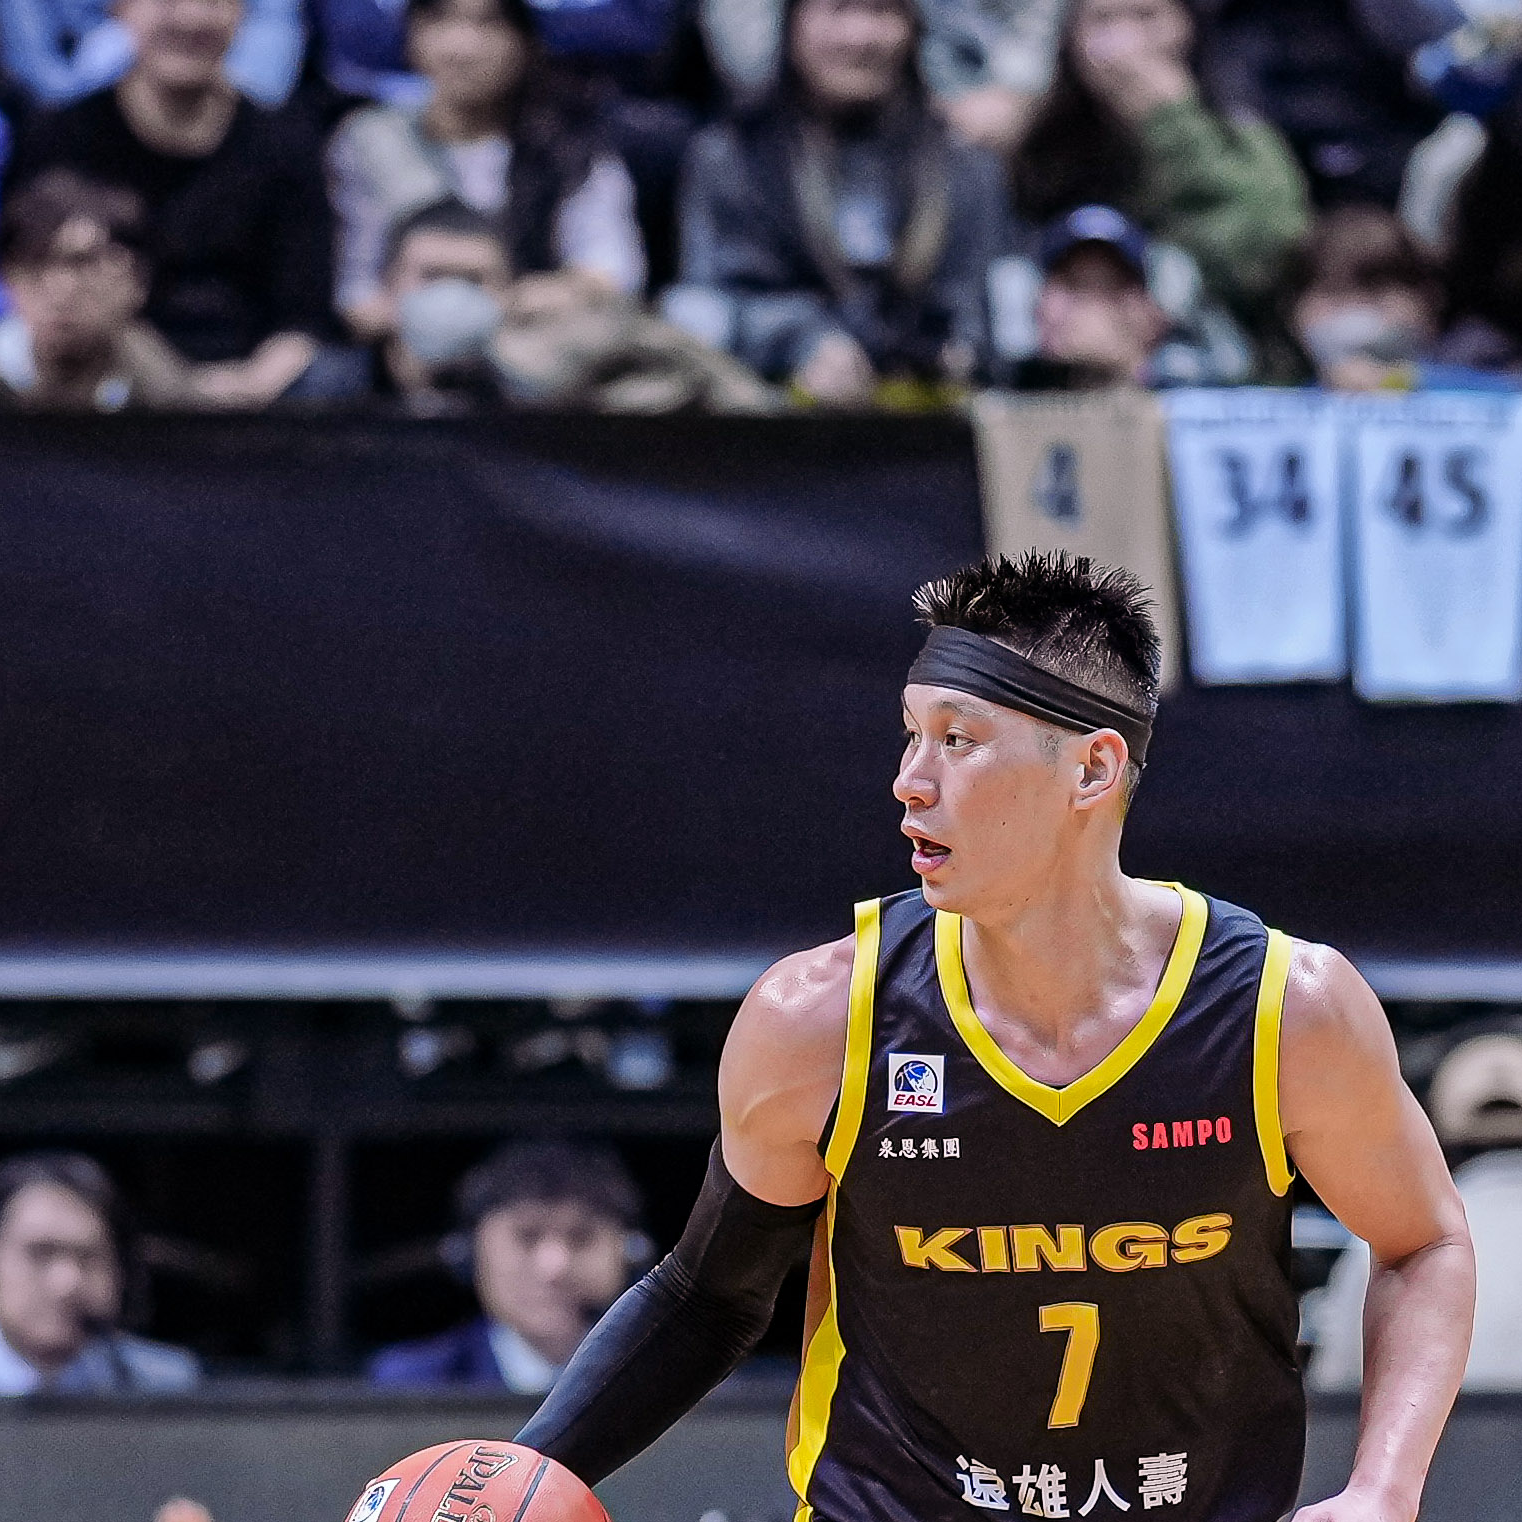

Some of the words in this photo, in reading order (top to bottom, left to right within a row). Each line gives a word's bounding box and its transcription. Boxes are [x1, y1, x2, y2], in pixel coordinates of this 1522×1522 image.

[1216, 446, 1312, 539] 34
[1387, 447, 1489, 538] 45
[893, 1093, 938, 1107] EASL
[1132, 1116, 1232, 1150] SAMPO
[894, 1212, 1232, 1272] KINGS
[1039, 1302, 1100, 1429] 7
[955, 1452, 1188, 1519] 遠雄人壽
